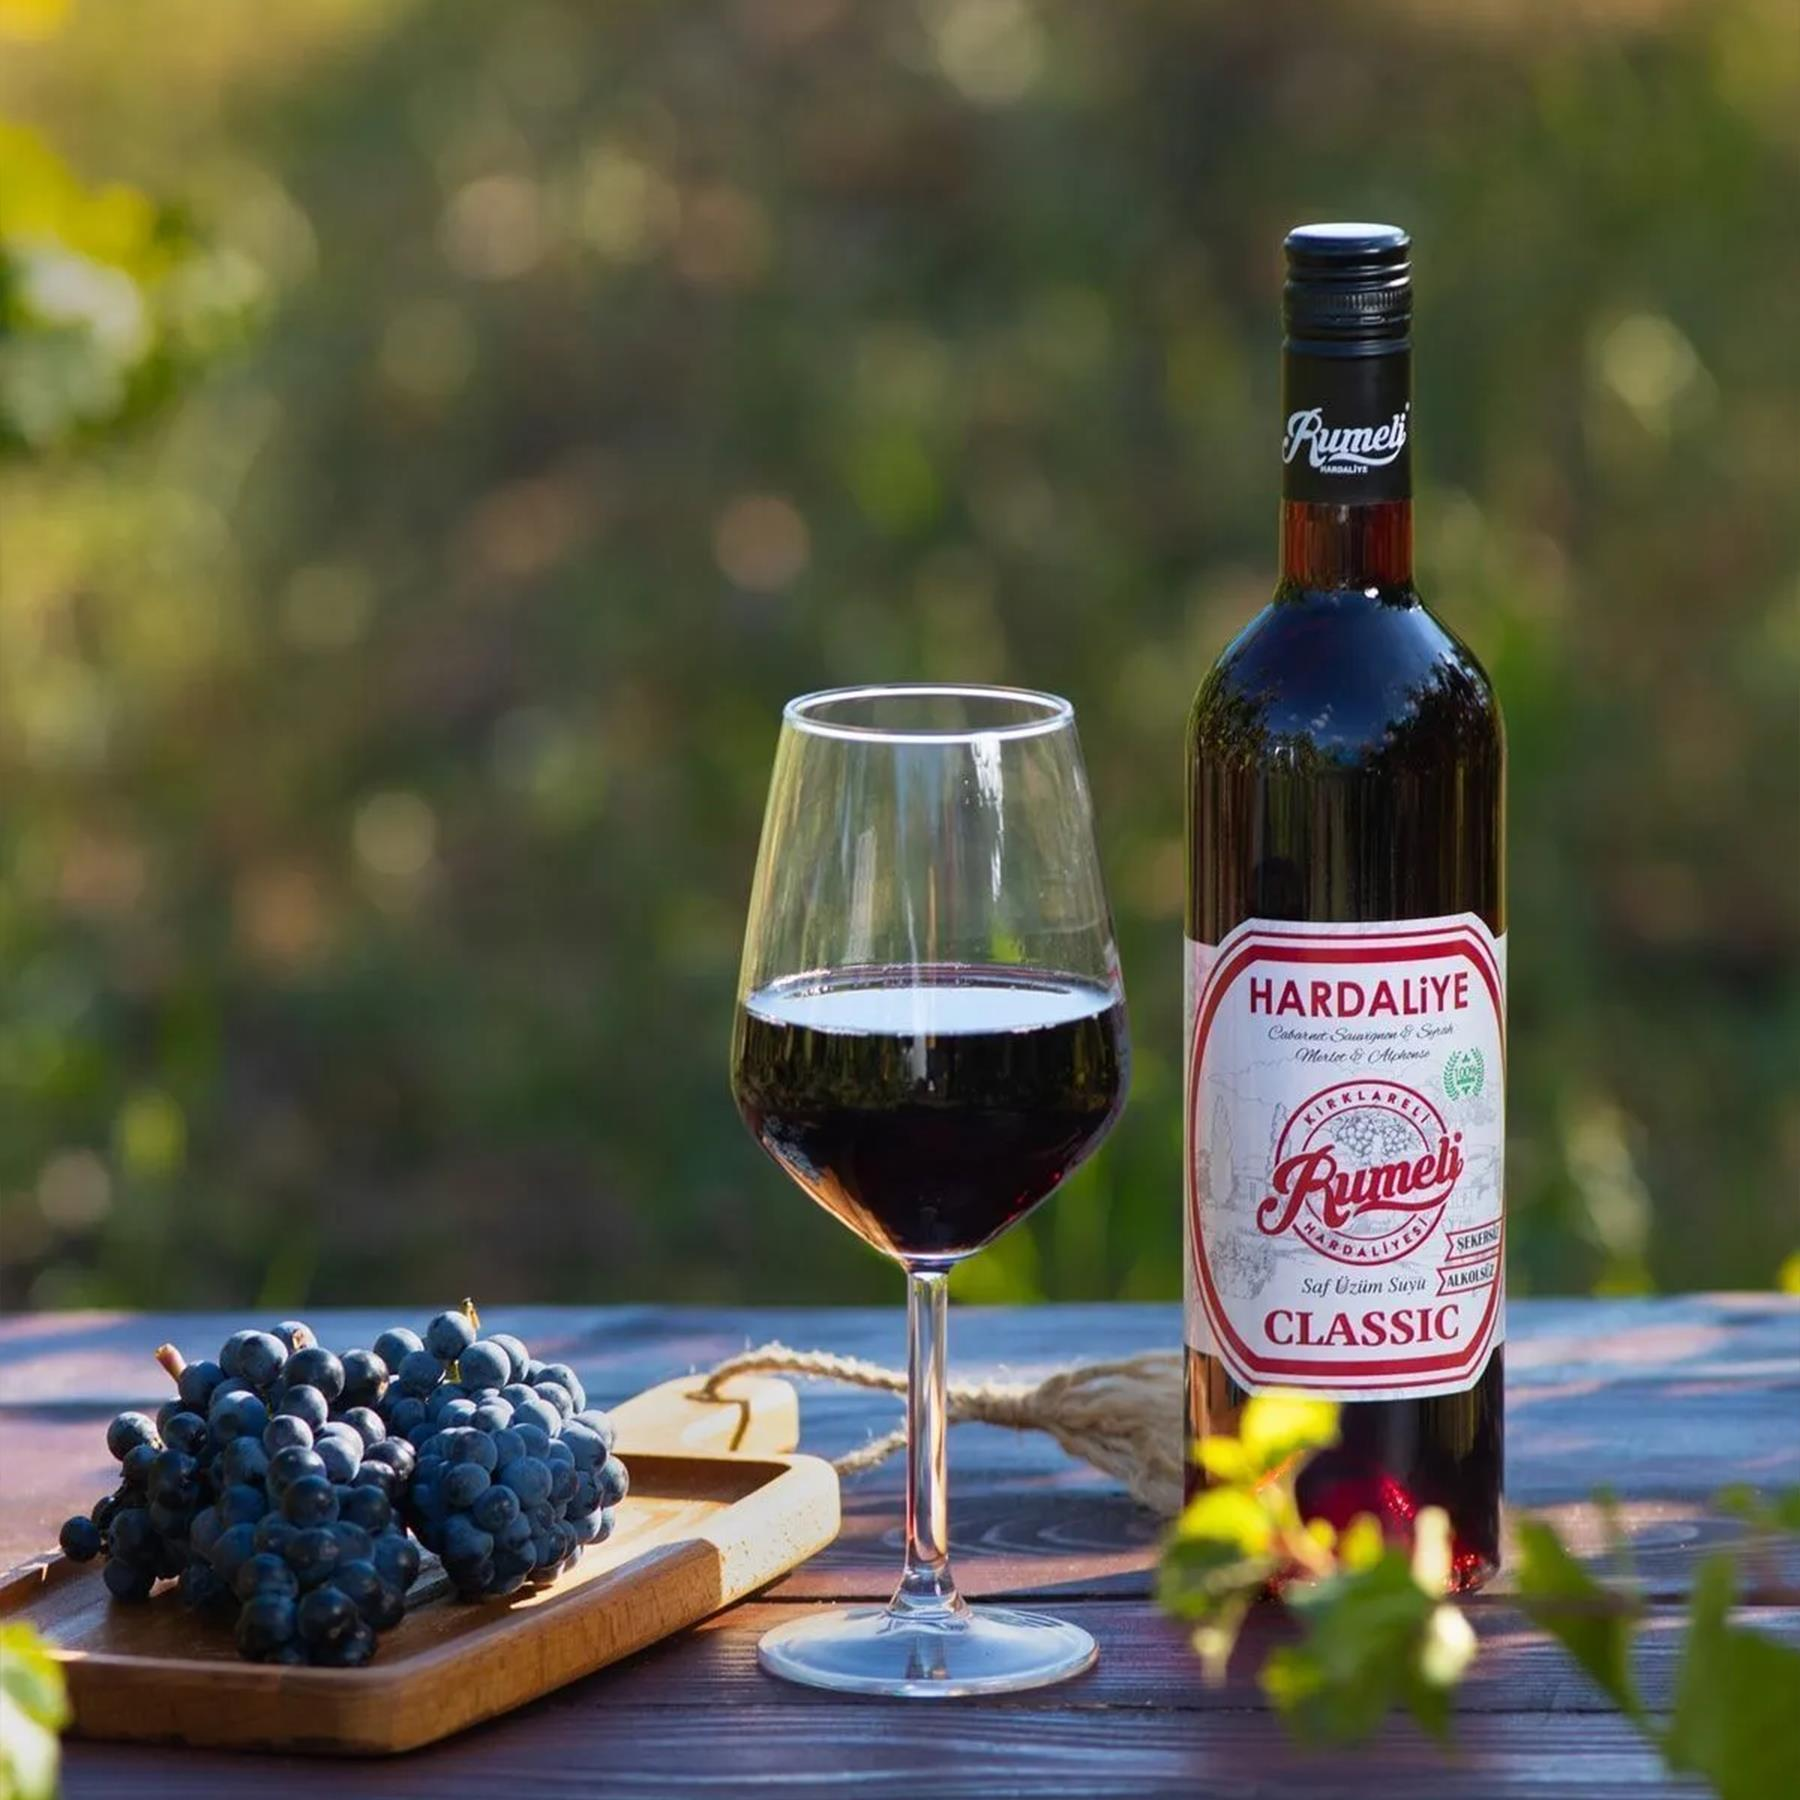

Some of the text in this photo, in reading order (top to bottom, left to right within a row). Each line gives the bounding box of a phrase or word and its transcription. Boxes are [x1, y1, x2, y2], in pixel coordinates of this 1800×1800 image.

[1282, 403, 1409, 468] Rumeli
[1330, 1027, 1397, 1045] Sauvignon
[1400, 1024, 1413, 1041] &
[1416, 1022, 1455, 1040] Syrah
[1295, 1046, 1430, 1064] Merlot & Alphonse
[1256, 1132, 1464, 1235] Rumeli
[1301, 1275, 1426, 1298] Saf Üzüm Suyu
[1264, 1304, 1459, 1346] CLASSIC
